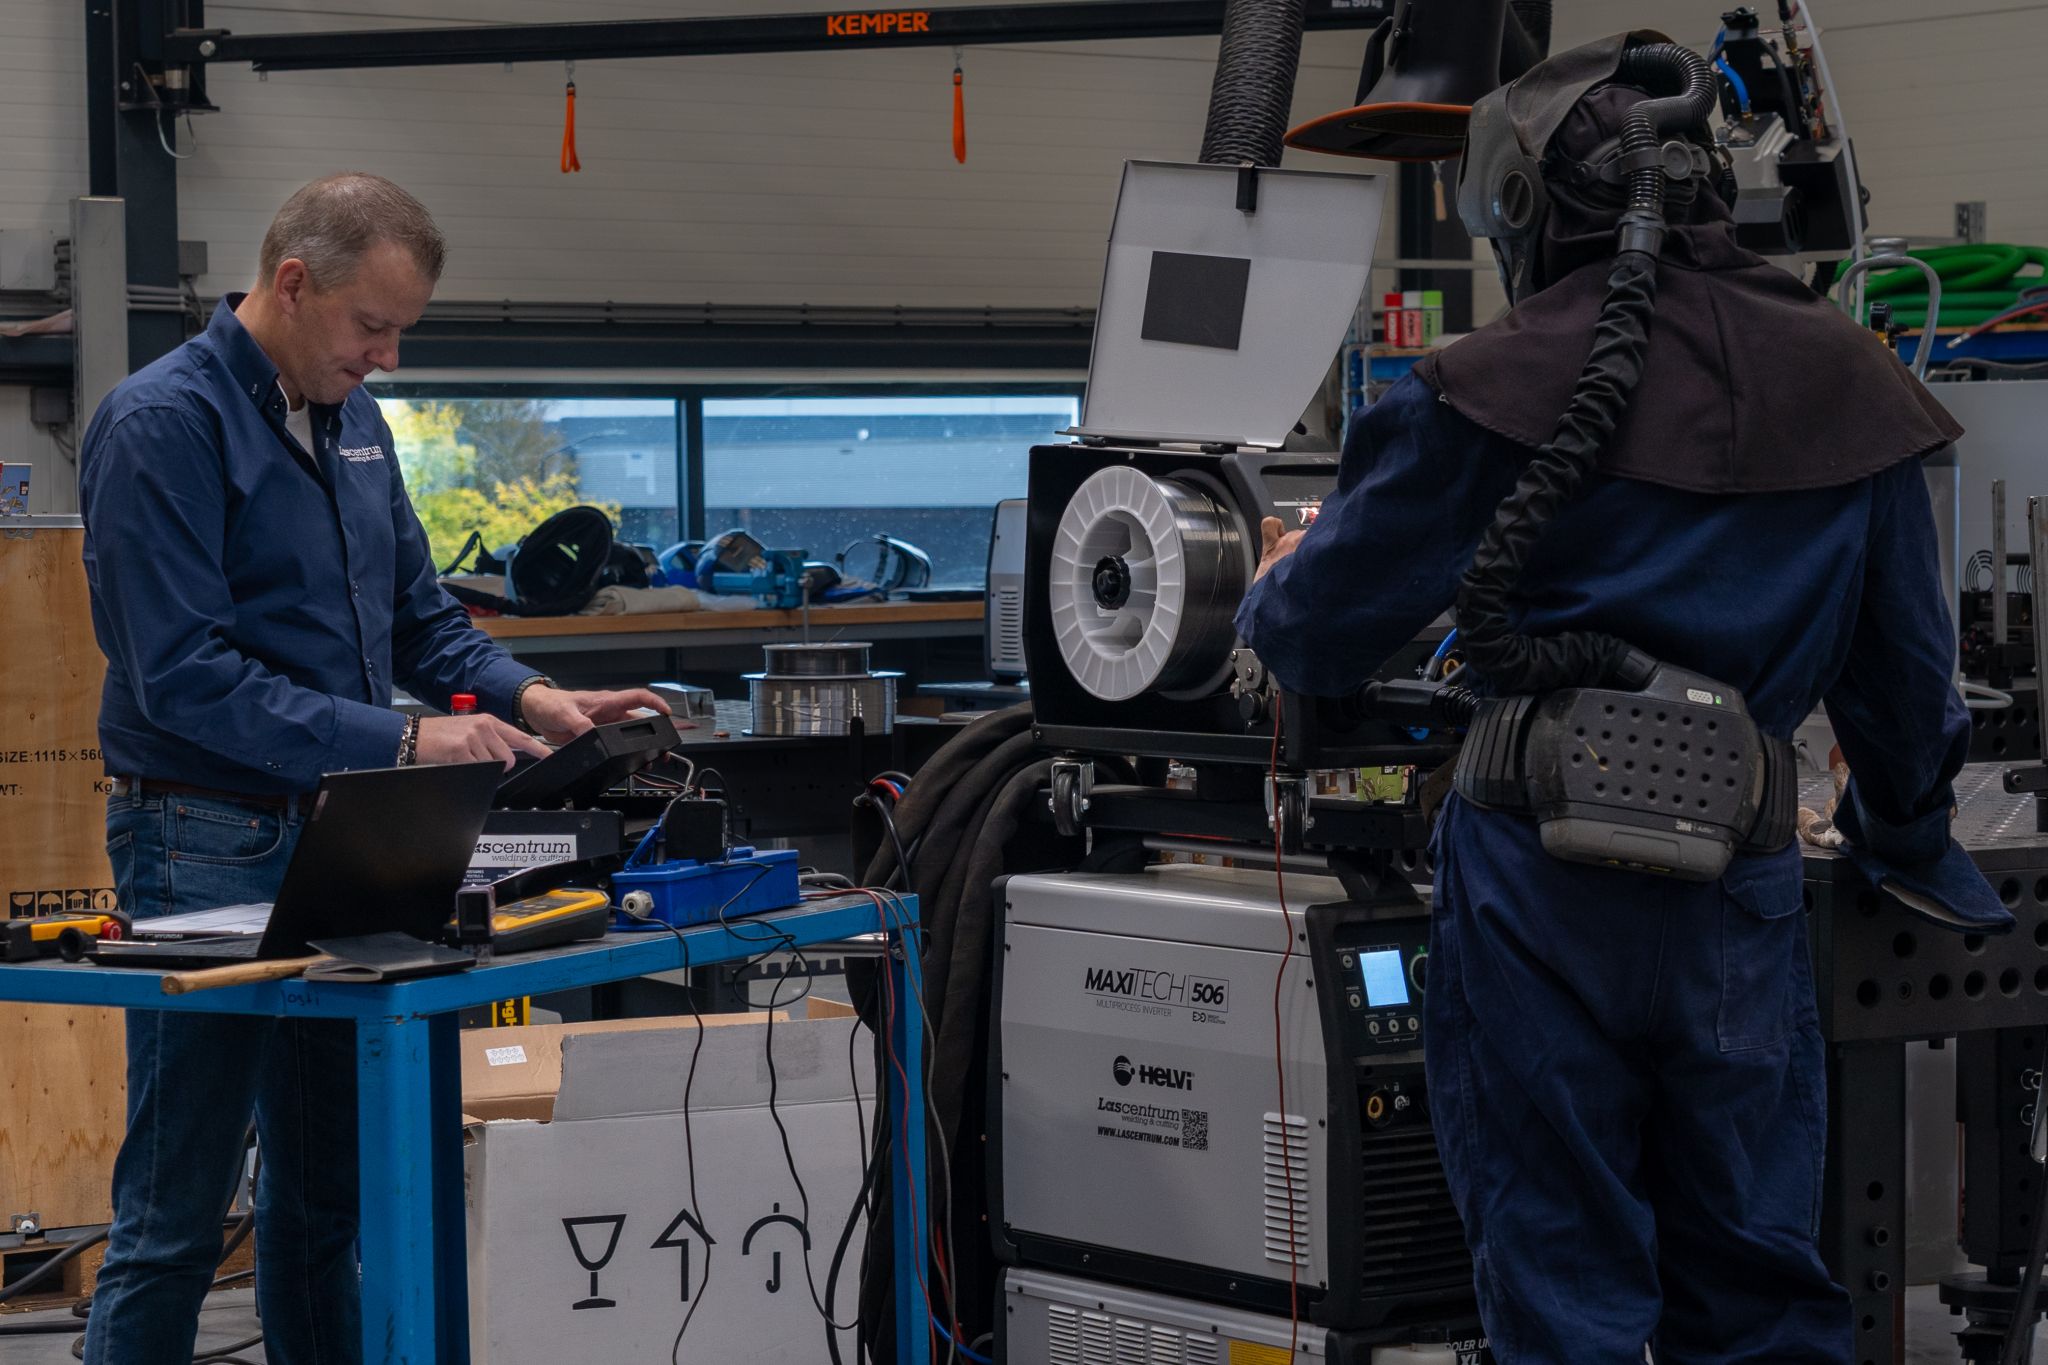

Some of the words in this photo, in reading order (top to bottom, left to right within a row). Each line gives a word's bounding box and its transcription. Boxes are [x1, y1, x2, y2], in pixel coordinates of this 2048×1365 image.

[827, 11, 929, 35] KEMPER
[94, 781, 112, 795] Kg
[475, 840, 571, 854] ascentrum
[492, 854, 528, 863] welding
[530, 854, 538, 862] &
[73, 899, 82, 909] UP
[1191, 982, 1225, 1005] 506
[1096, 1000, 1142, 1014] MULTIPROCESS
[1142, 1005, 1172, 1017] INVERTER
[1098, 1097, 1180, 1121] Lascentrum
[1121, 1115, 1147, 1126] welding
[1156, 1120, 1179, 1130] cutting
[1098, 1126, 1180, 1147] WWW.LASCENTRUM.COM
[1461, 1353, 1479, 1365] XL
